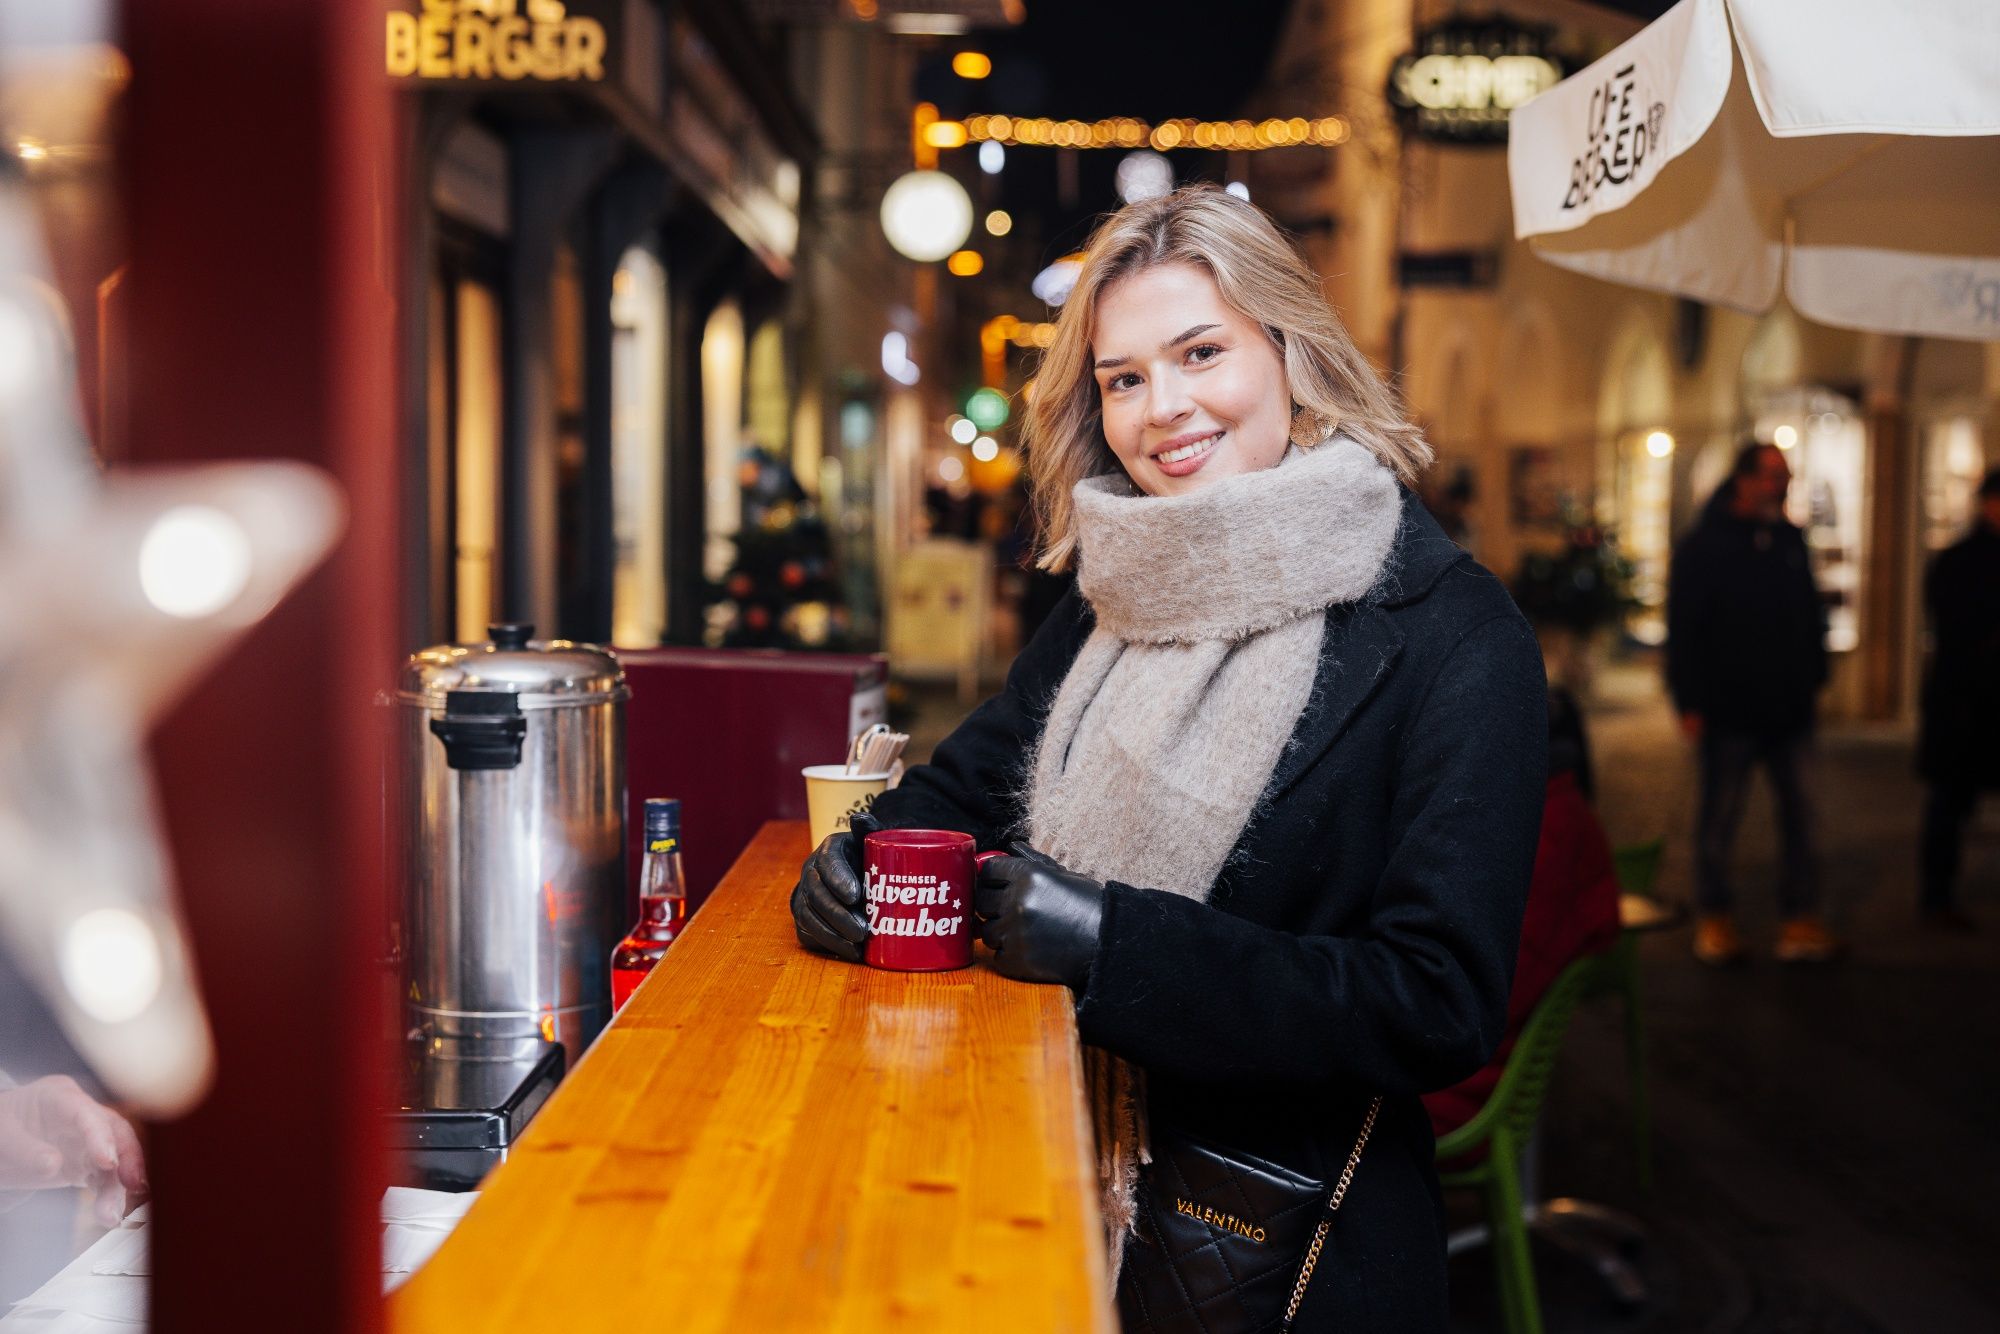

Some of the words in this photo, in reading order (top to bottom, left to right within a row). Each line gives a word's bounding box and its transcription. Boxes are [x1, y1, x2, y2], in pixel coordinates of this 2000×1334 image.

[386, 11, 606, 80] BERGER
[1562, 122, 1646, 209] BEGER
[863, 871, 951, 905] Advent
[889, 874, 937, 884] KREMSER
[865, 902, 963, 937] Zauber
[1177, 1197, 1266, 1242] VALENTINO
